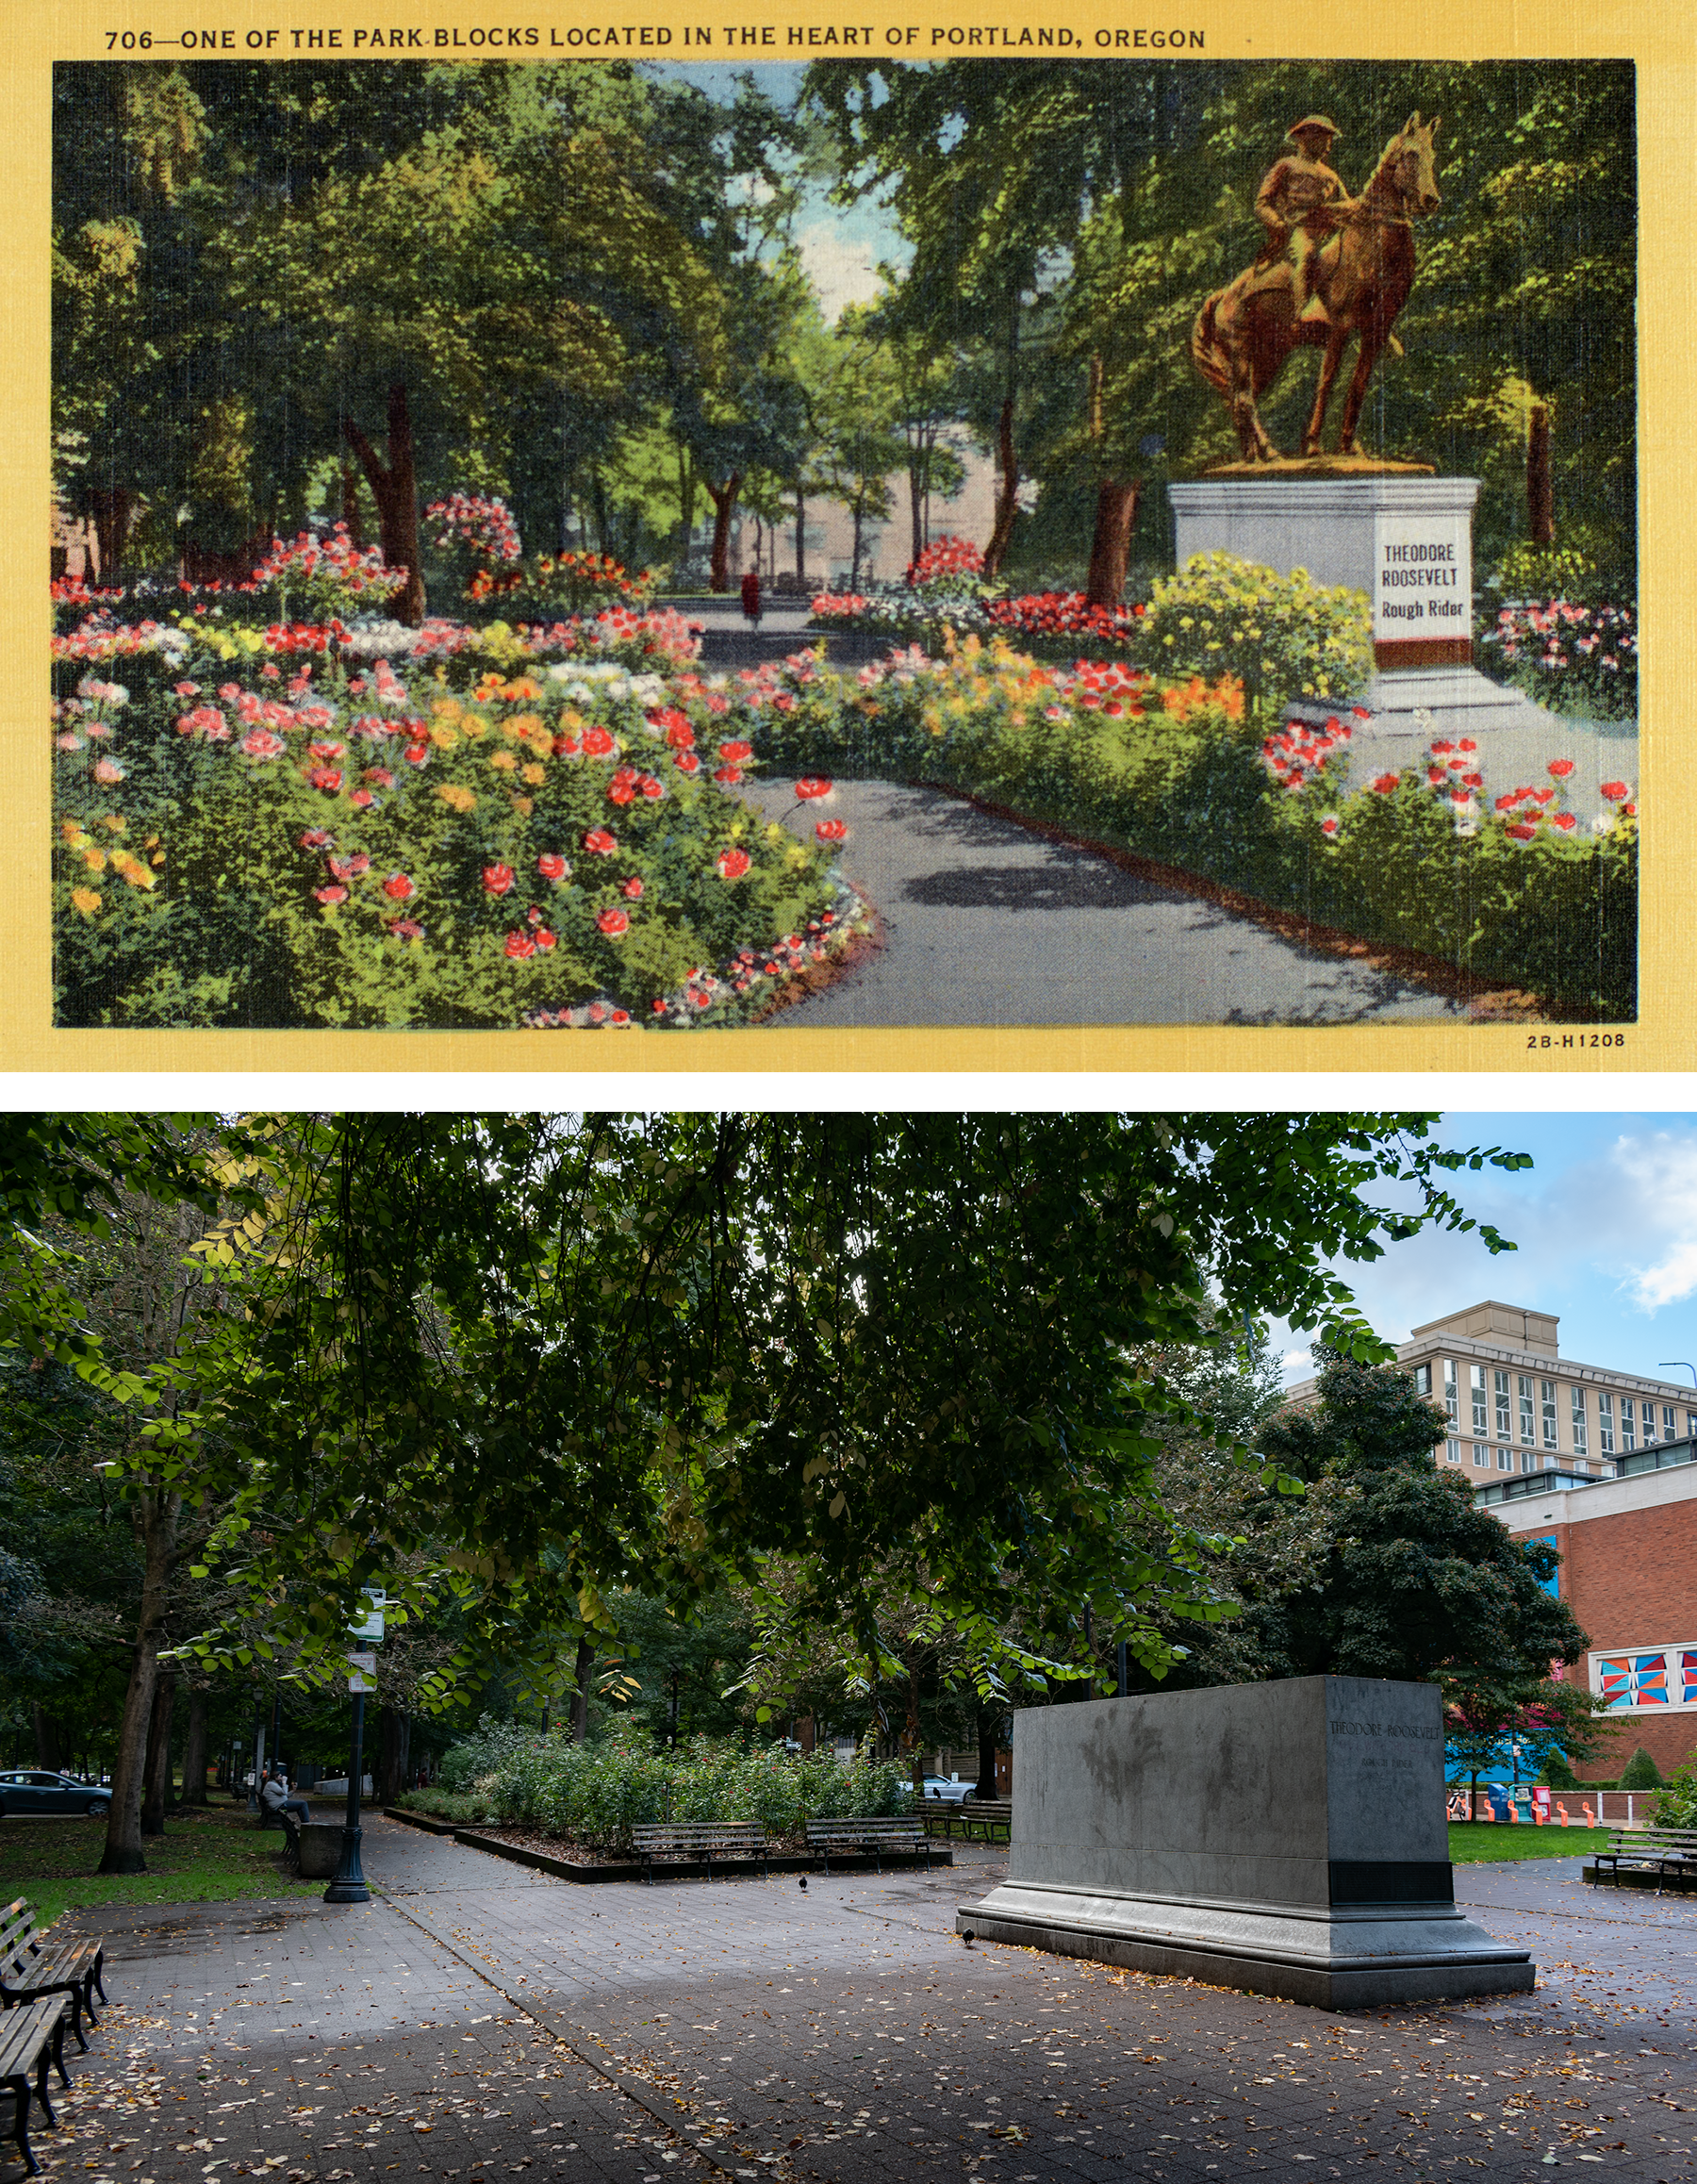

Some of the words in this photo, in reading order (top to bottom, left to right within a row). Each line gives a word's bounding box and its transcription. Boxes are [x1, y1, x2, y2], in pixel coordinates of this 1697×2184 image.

[246, 29, 279, 48] OF
[290, 29, 342, 47] THE
[354, 29, 422, 47] PARK
[435, 27, 538, 47] BLOCKS
[551, 27, 671, 46] LOCATED
[684, 26, 711, 45] IN
[723, 26, 775, 45] THE
[788, 26, 874, 45] HEART
[886, 26, 919, 45] OF
[931, 26, 1083, 49] PORTLAND,
[1095, 28, 1205, 48] OREGON
[1384, 544, 1455, 562] THEODORE
[1382, 568, 1458, 587] ROOSEVELT
[1382, 601, 1424, 620] Rough
[1428, 600, 1463, 617] Rider
[1527, 1034, 1624, 1049] 2B-H1208
[1329, 1720, 1382, 1737] THEODORE
[1387, 1724, 1441, 1740] ROOSEVELT
[1361, 1758, 1388, 1768] ROUGH
[1392, 1760, 1413, 1770] RIDER
